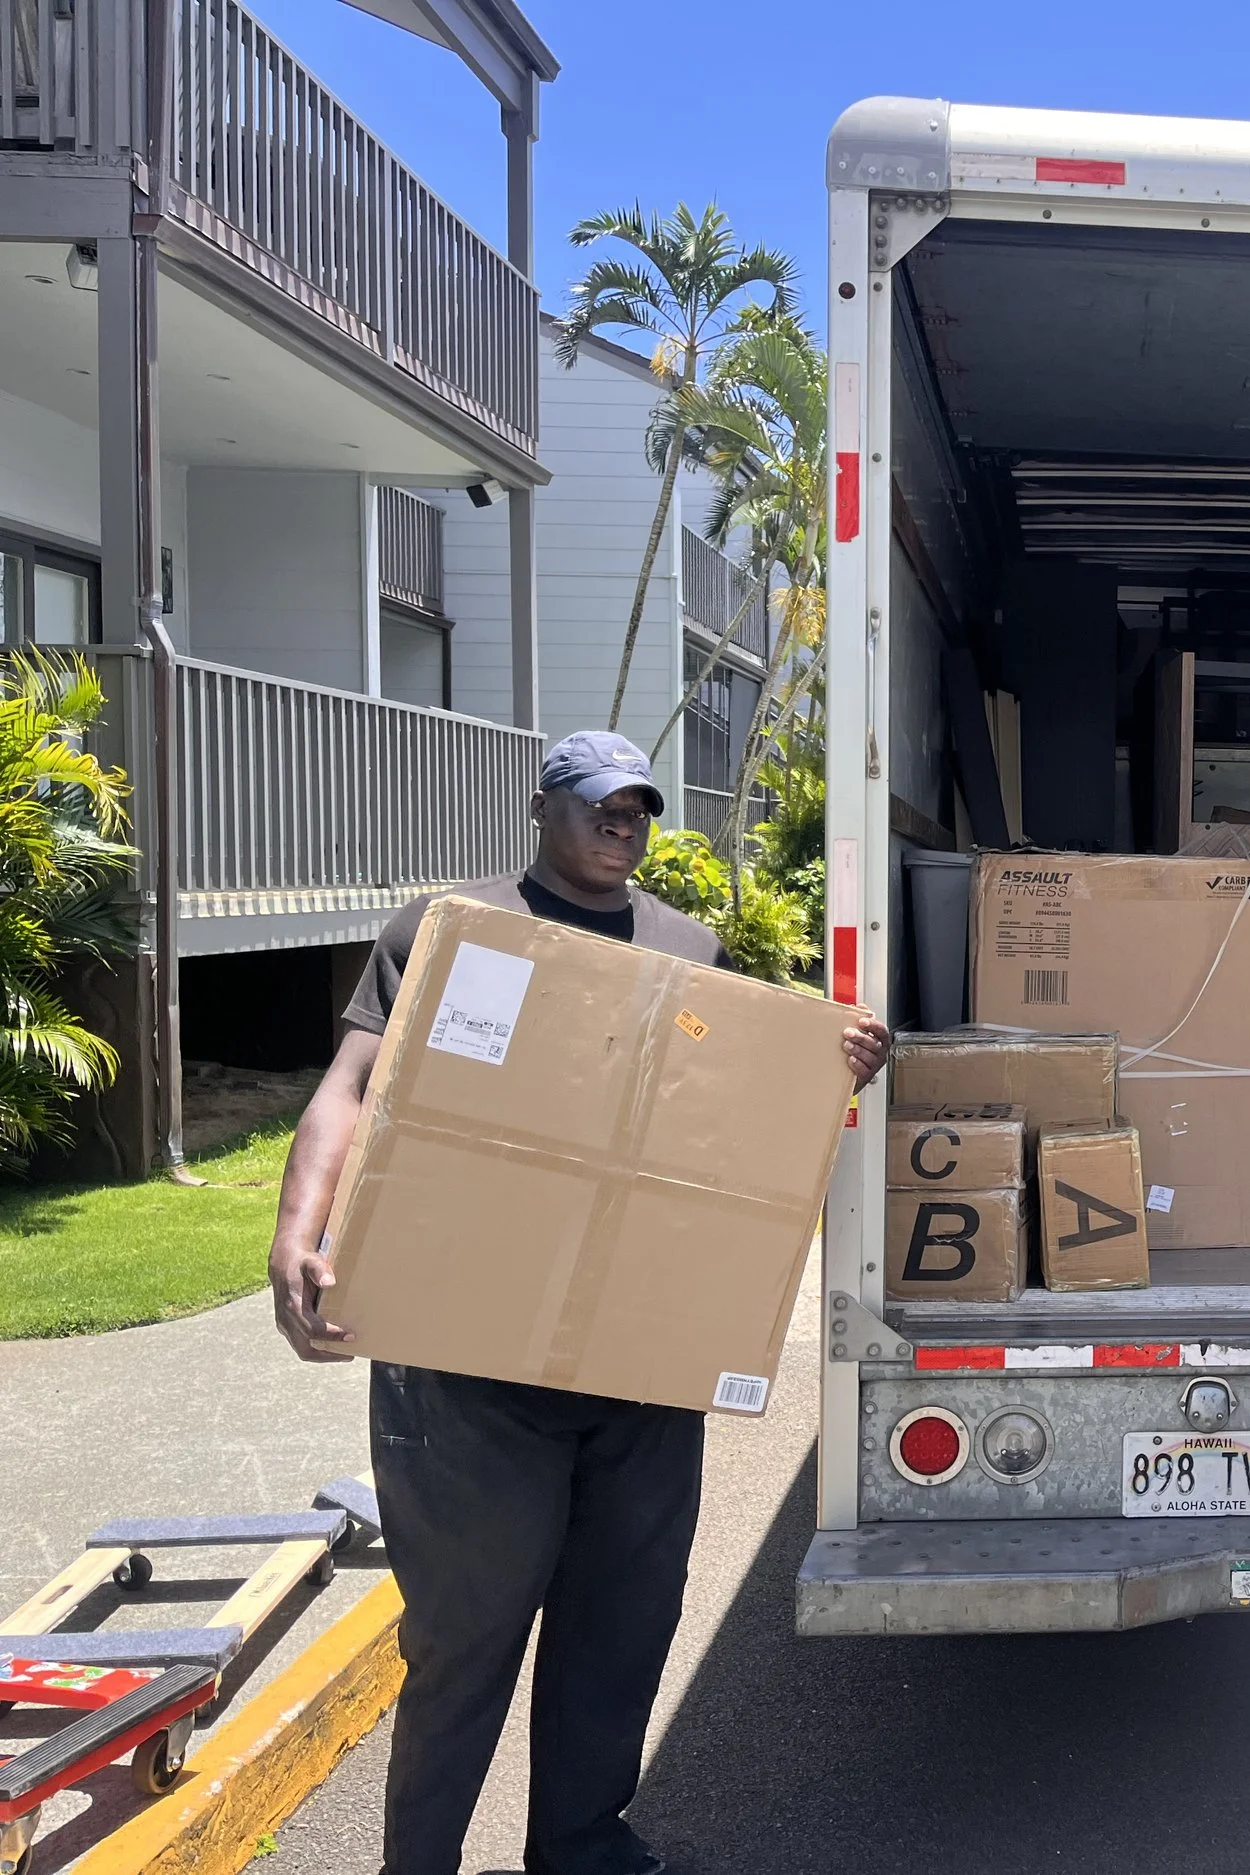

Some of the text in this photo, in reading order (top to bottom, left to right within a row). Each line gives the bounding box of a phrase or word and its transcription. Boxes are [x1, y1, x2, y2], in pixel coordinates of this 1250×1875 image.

[1000, 870, 1073, 885] ASSAULT
[1225, 876, 1246, 885] CARB
[998, 884, 1068, 898] FITNESS
[694, 1026, 704, 1036] D
[910, 1127, 962, 1180] C
[1054, 1179, 1138, 1251] A
[902, 1202, 980, 1282] B
[1184, 1438, 1232, 1448] HAWAII
[1132, 1453, 1196, 1496] 898
[1167, 1501, 1246, 1511] ALOHA STATE
